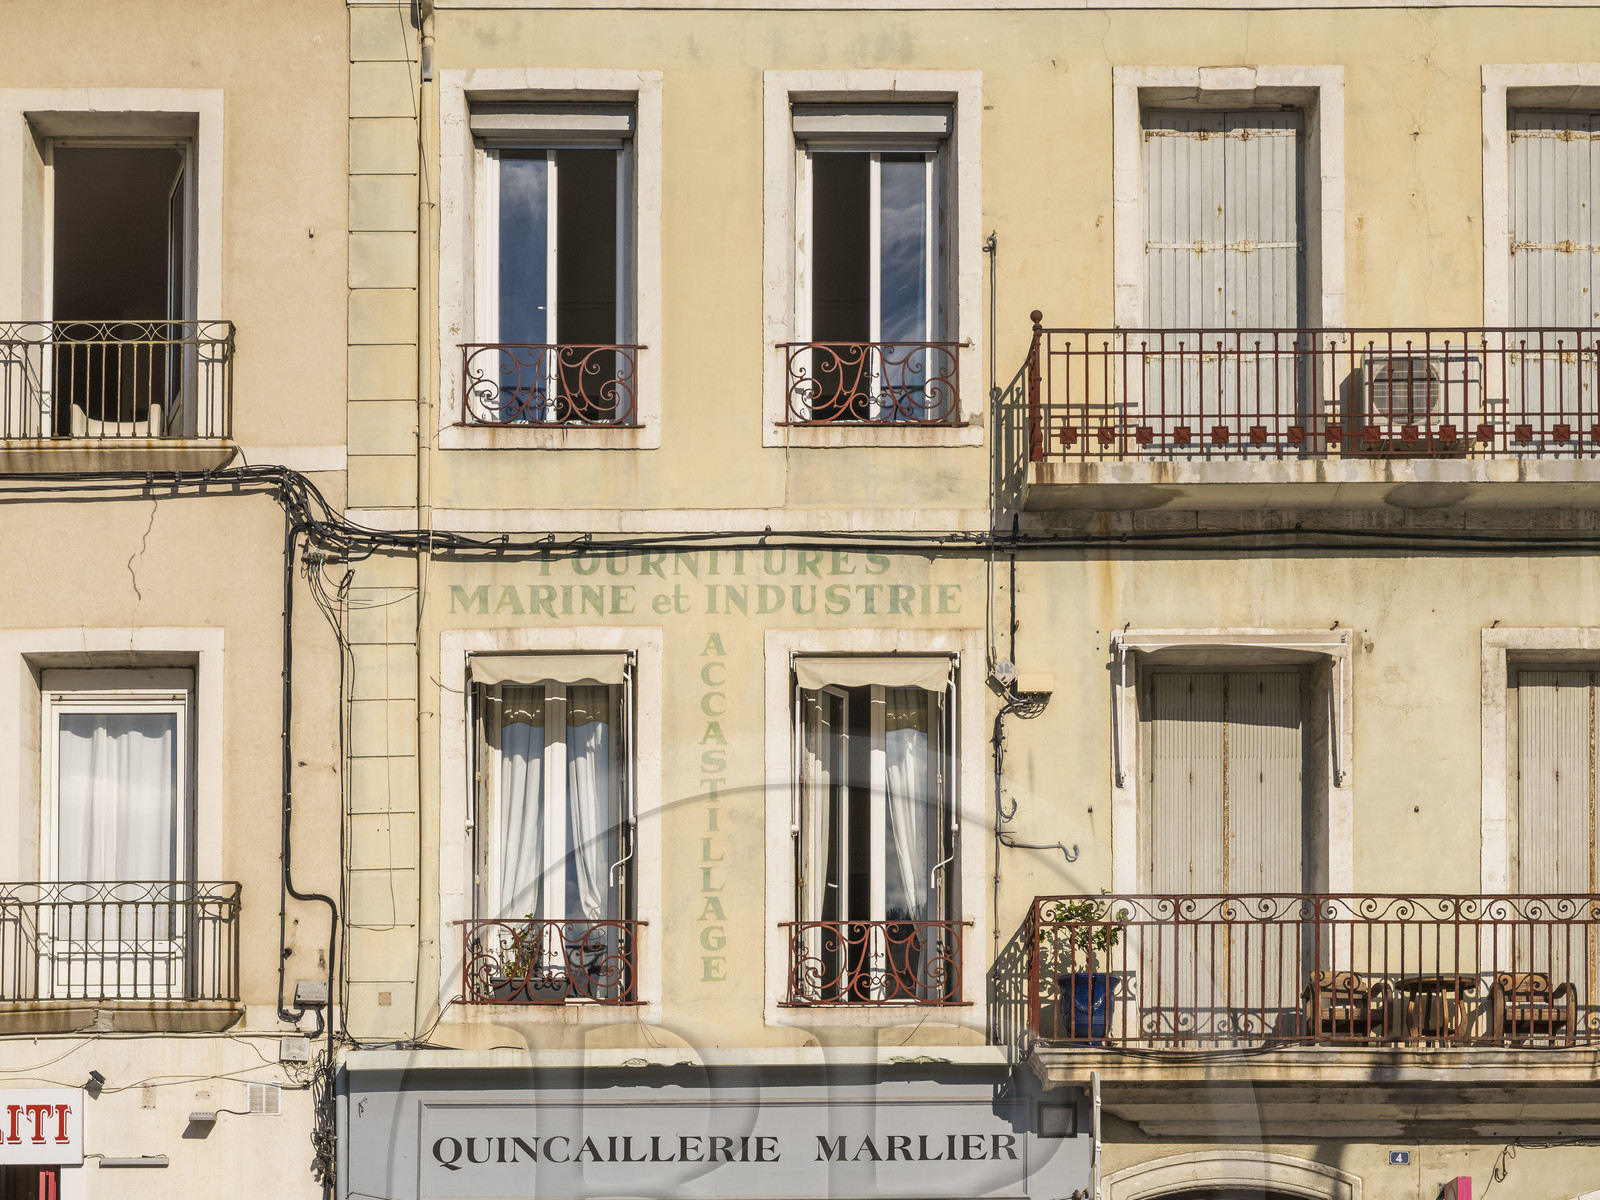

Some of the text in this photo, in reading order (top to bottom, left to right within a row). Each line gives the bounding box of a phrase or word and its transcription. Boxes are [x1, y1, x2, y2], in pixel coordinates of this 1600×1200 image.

[448, 583, 962, 618] MARINE et INDUSTRIE
[698, 632, 729, 982] ACCASTILLAGE
[0, 1105, 72, 1144] ITI
[432, 1134, 1020, 1171] QUINCAILLERIE MARLIER
[1395, 1153, 1403, 1163] 4
